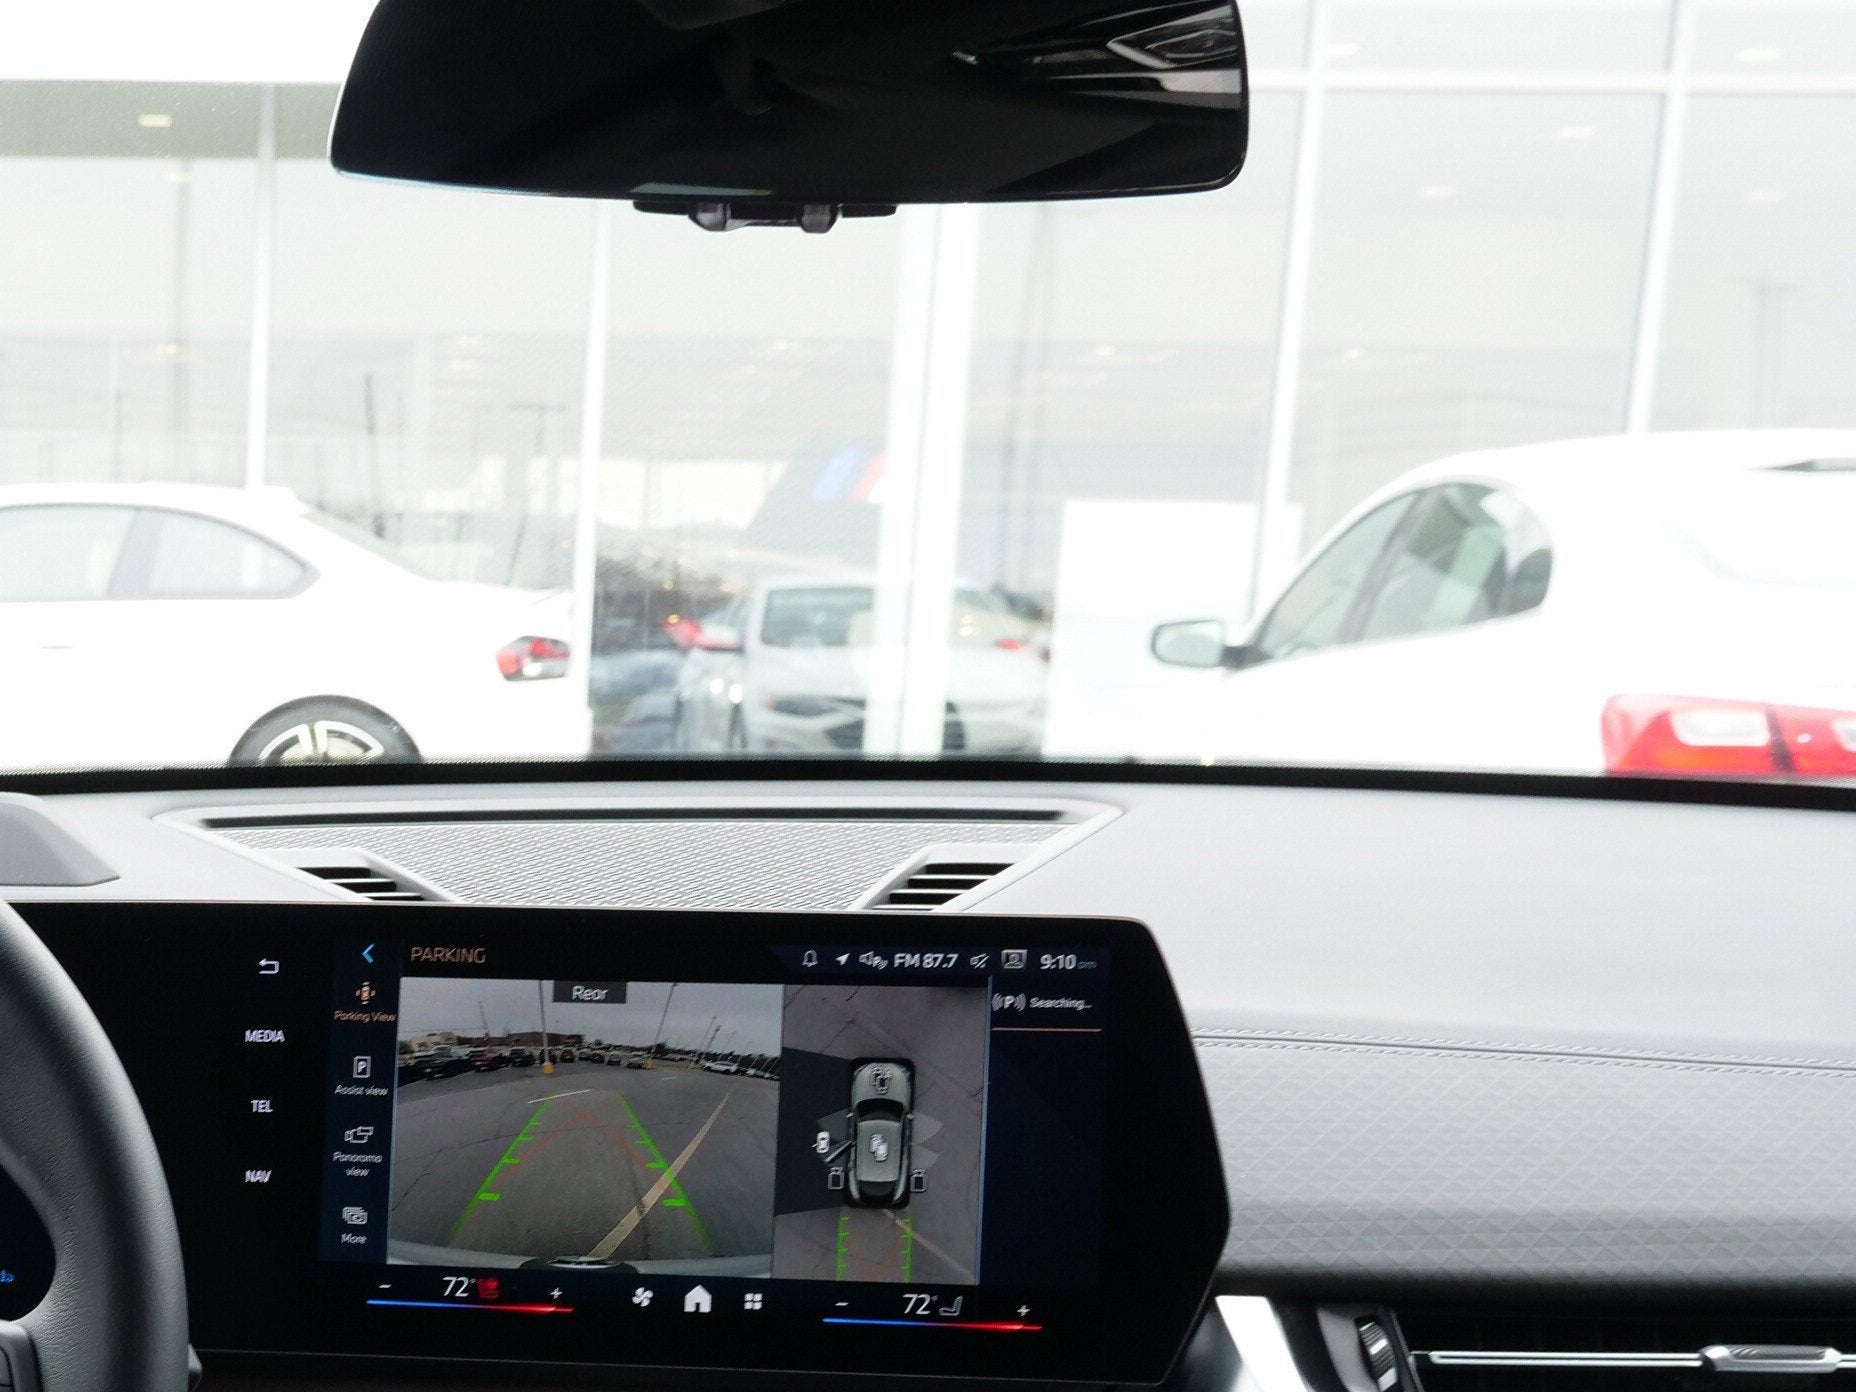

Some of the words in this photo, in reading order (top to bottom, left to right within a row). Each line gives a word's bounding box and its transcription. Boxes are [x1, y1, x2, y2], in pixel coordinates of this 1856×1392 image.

[411, 947, 485, 963] PARKING
[894, 953, 920, 967] FM
[923, 953, 958, 968] 87.7
[1041, 954, 1076, 969] 9:10
[245, 1030, 285, 1042] MEDIA
[251, 1100, 273, 1112] TEL
[245, 1170, 271, 1183] NAV
[342, 1233, 367, 1244] More
